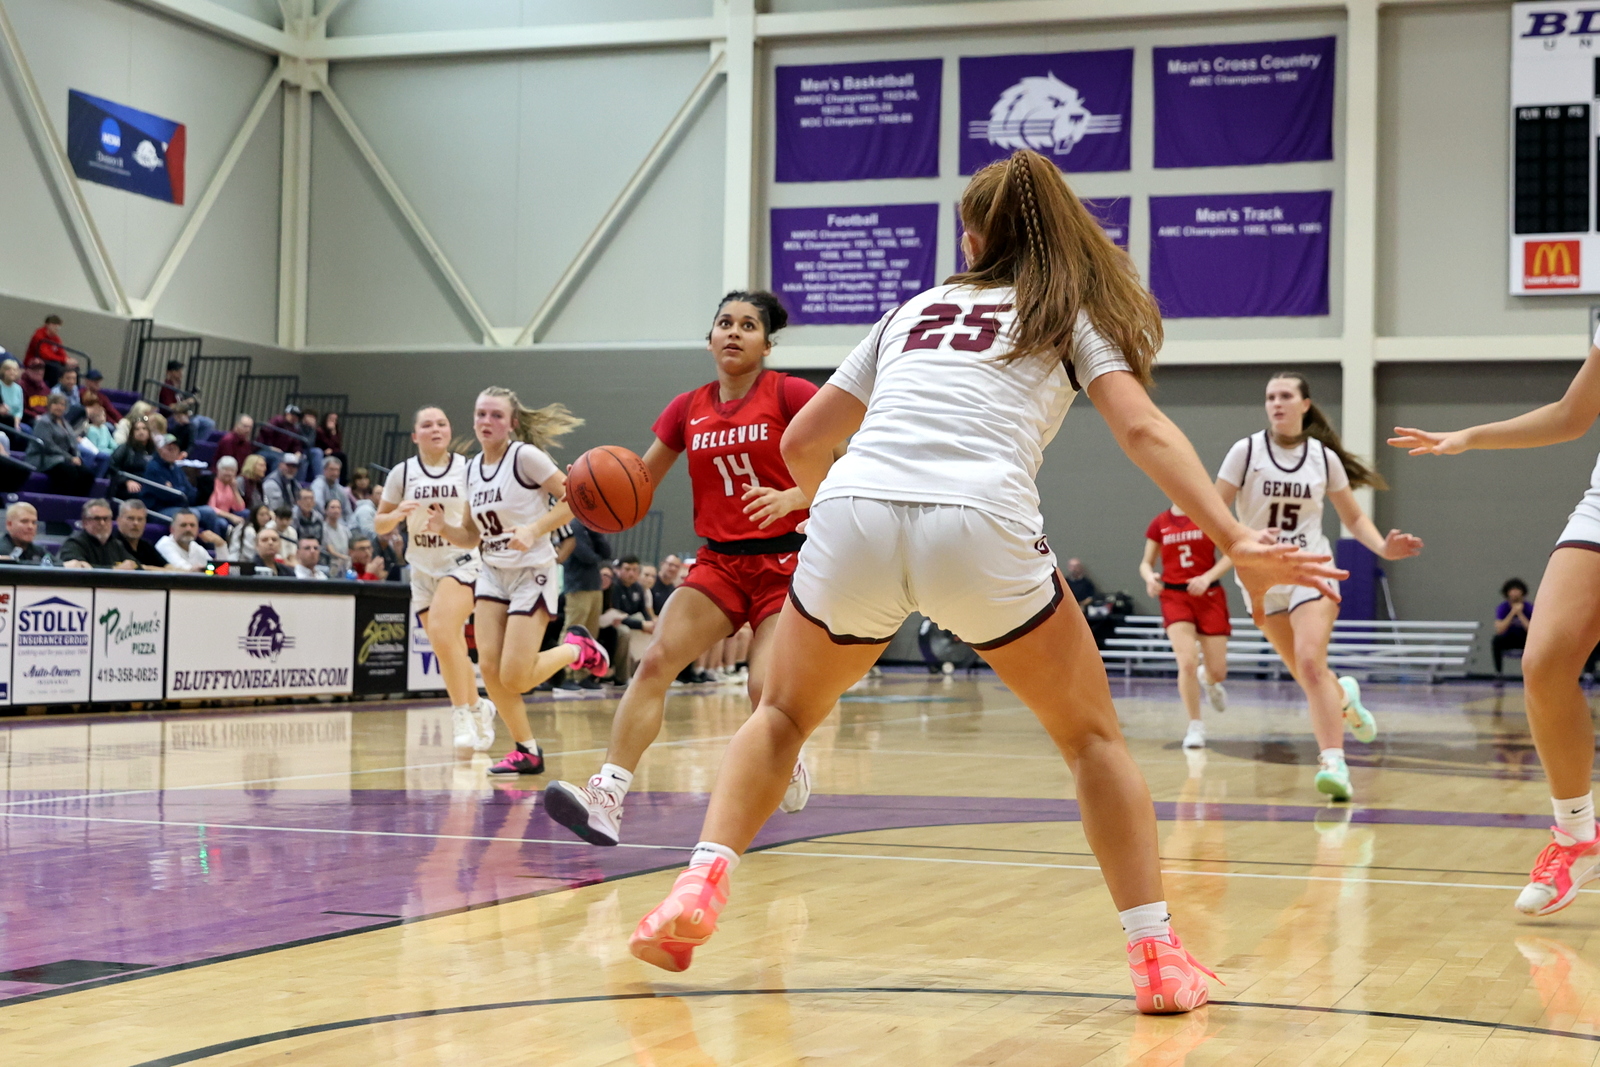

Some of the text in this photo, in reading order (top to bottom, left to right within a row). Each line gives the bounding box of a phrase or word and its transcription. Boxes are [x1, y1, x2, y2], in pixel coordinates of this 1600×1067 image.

[1167, 53, 1321, 74] Men's Cross Country
[800, 73, 914, 92] Men's Basketball
[827, 213, 879, 227] Football
[1195, 205, 1284, 223] Men's Track
[902, 303, 1013, 353] 25
[692, 423, 769, 451] BELLEVUE
[713, 453, 760, 497] 14
[414, 485, 458, 499] GENOA
[1263, 480, 1312, 499] GENOA
[1267, 503, 1301, 531] 15
[1162, 529, 1204, 545] BELLEVUE
[1178, 544, 1194, 568] 2
[535, 574, 547, 586] G
[18, 610, 88, 632] STOLLY
[19, 635, 62, 646] INSURANCE
[64, 635, 88, 646] GROUP
[131, 642, 156, 654] PIZZA
[23, 664, 81, 678] Auto-Owners
[173, 668, 349, 690] BLUFFTONBEAVERS.COM
